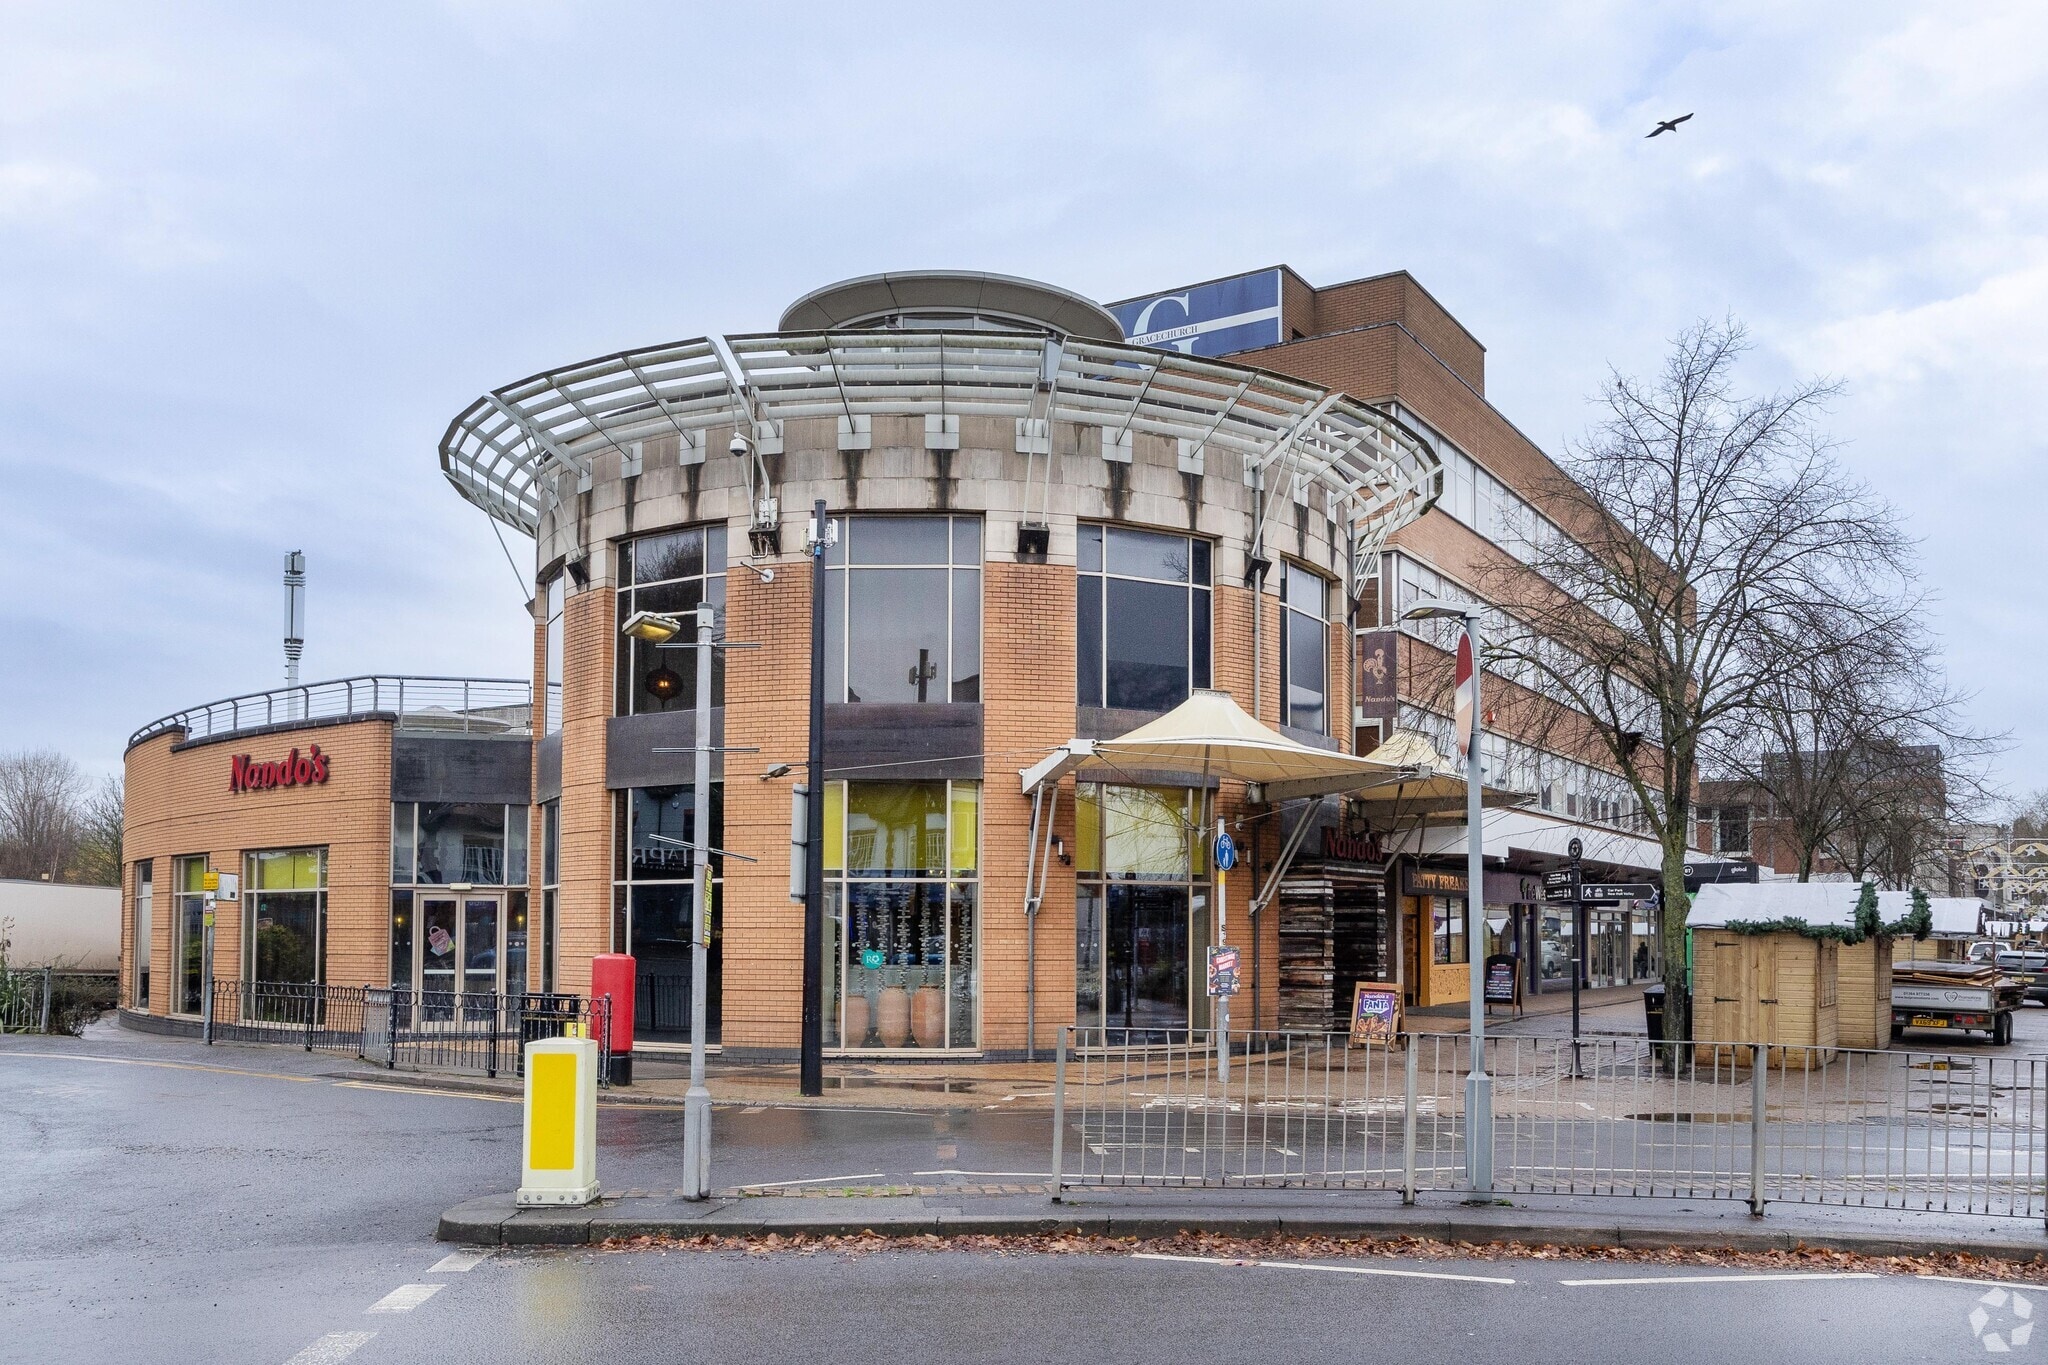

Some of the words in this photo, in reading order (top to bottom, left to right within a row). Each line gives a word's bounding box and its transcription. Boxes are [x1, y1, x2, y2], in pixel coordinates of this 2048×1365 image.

[1132, 325, 1198, 345] GRACECHURCH
[1364, 695, 1396, 703] Nando's
[228, 743, 330, 794] Nando's
[1731, 866, 1747, 874] global
[1412, 873, 1437, 889] PATTY
[1364, 1000, 1388, 1009] FANTA
